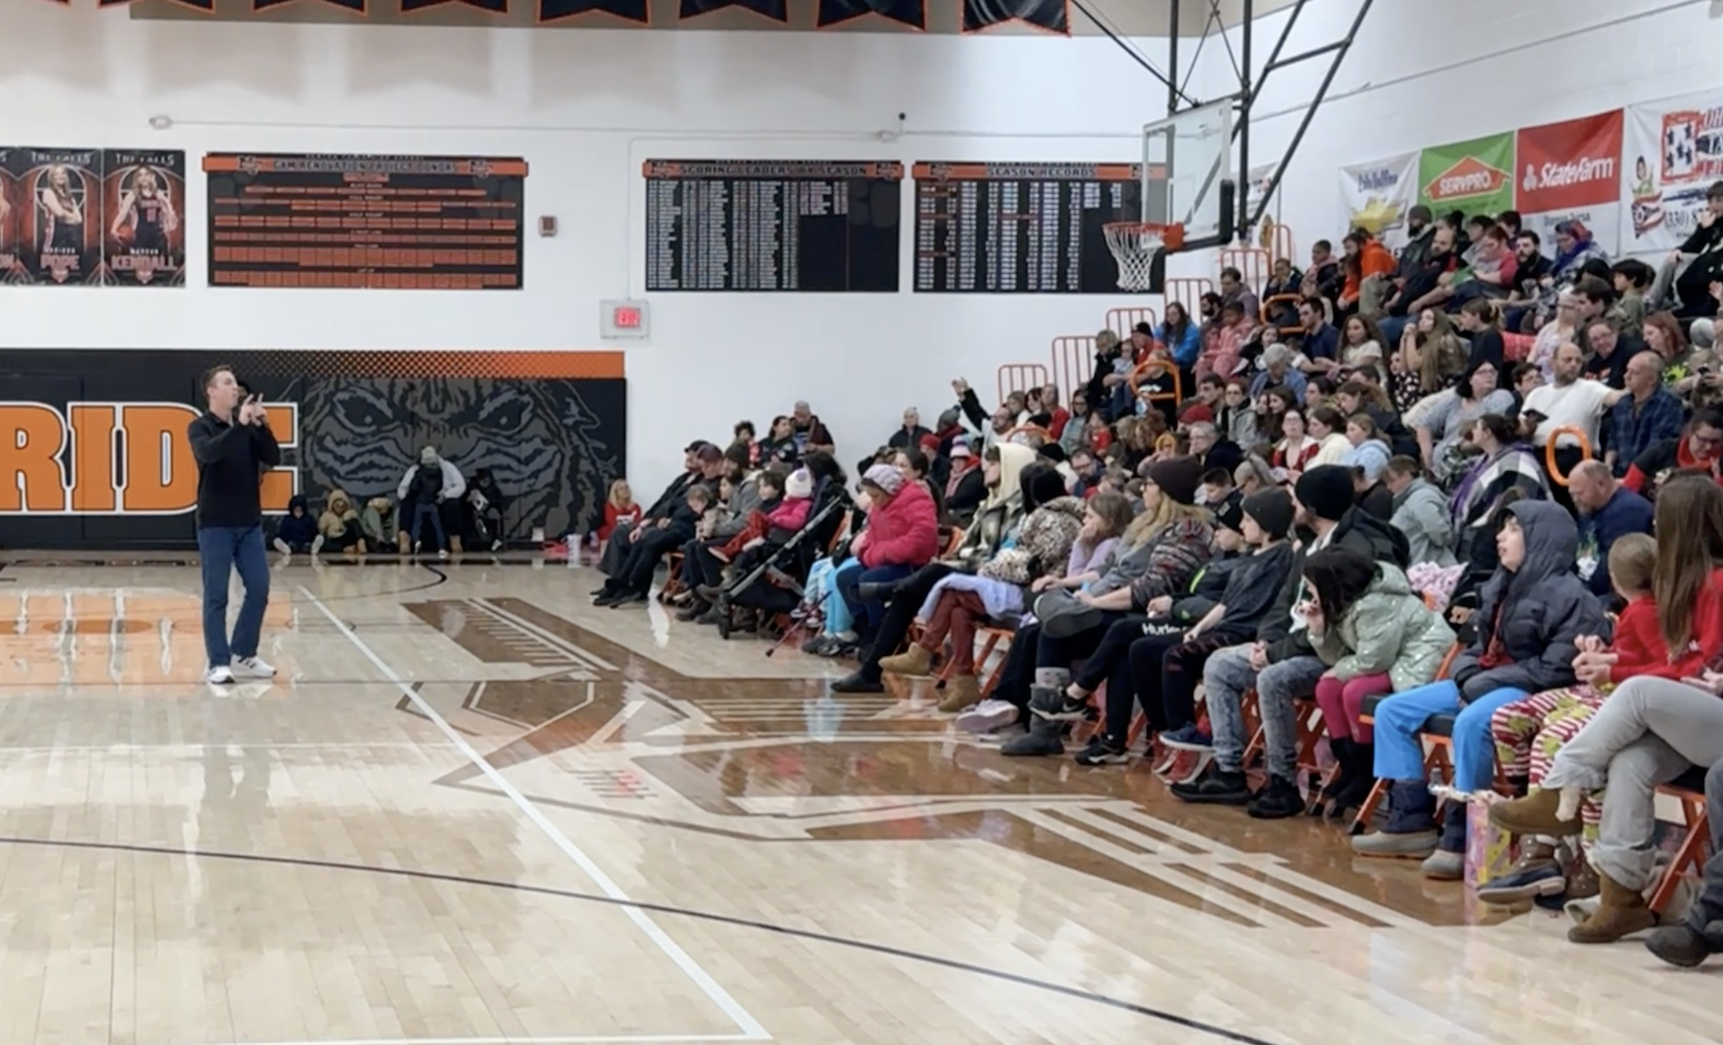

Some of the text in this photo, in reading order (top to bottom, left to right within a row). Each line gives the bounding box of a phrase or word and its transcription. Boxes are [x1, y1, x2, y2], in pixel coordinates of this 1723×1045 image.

[682, 164, 735, 174] SCORING
[739, 165, 795, 174] LEADERS
[818, 166, 867, 175] SEASON
[987, 167, 1097, 177] SEASON RECORDS
[1439, 171, 1492, 195] SERVPRO
